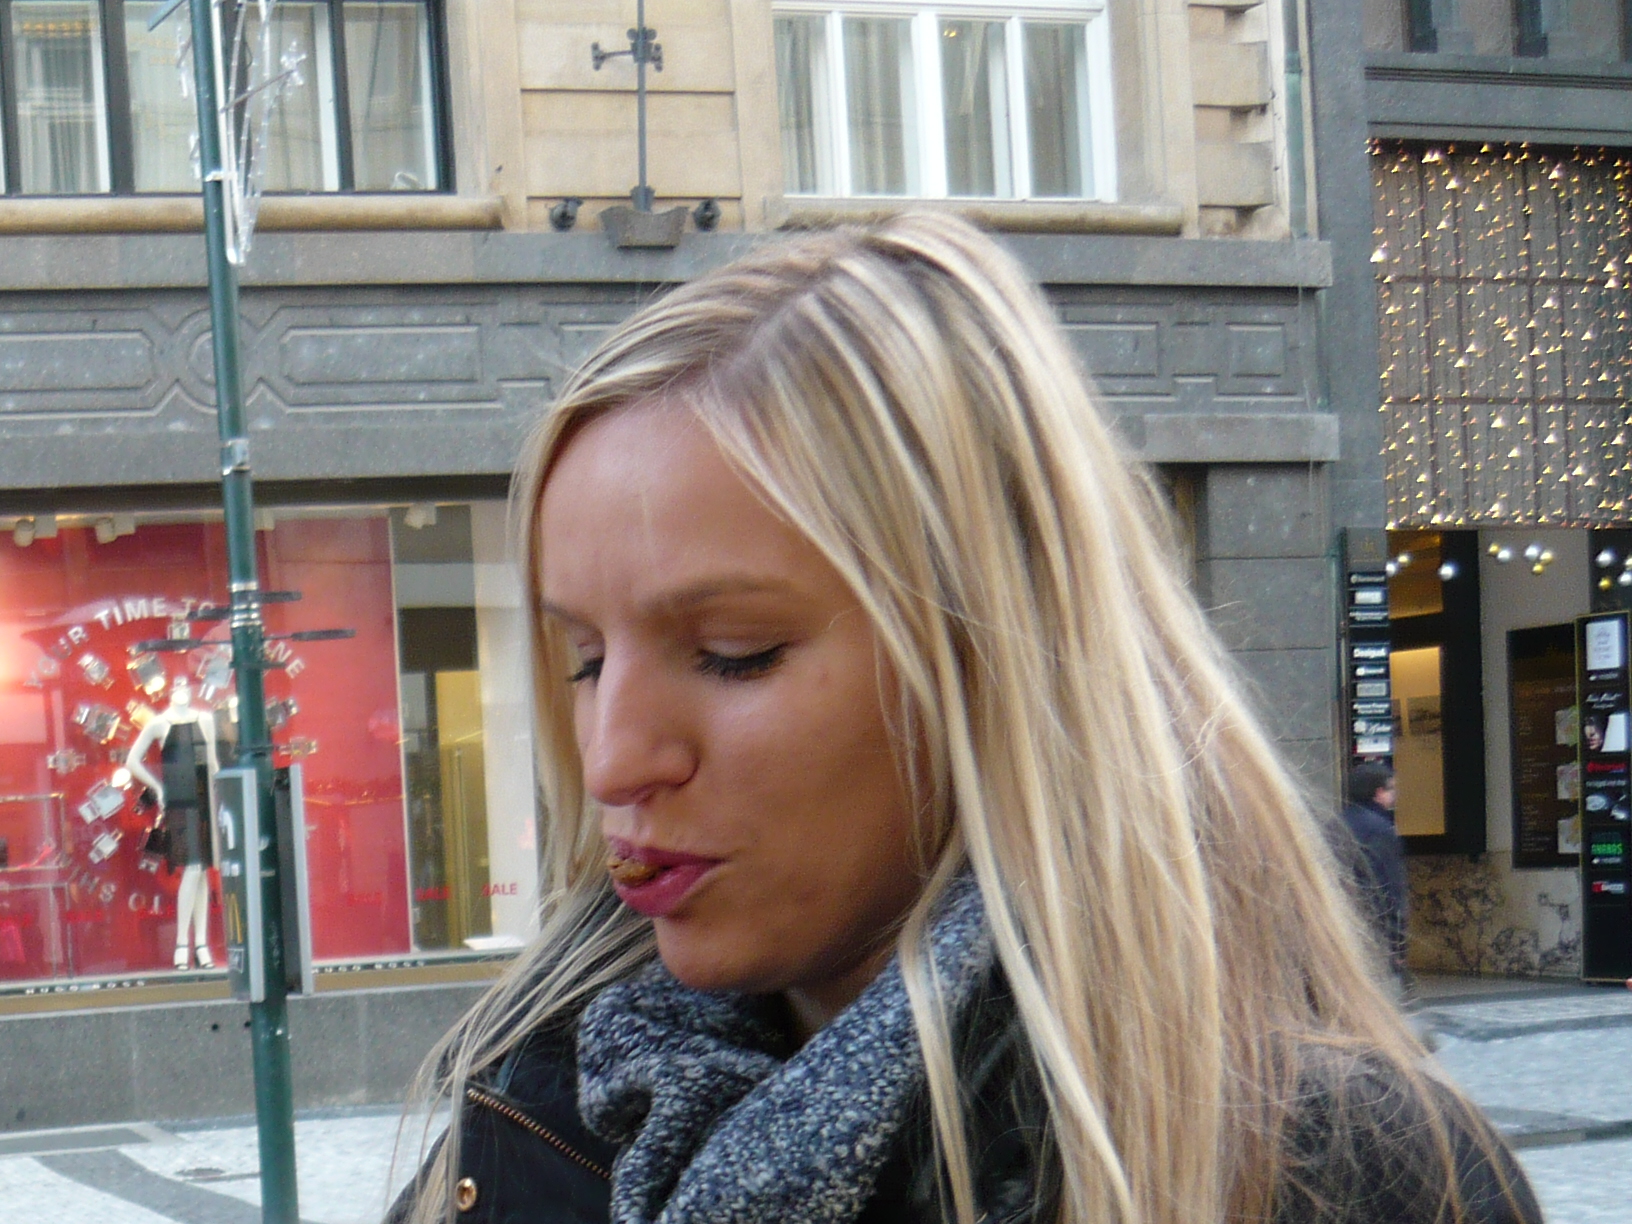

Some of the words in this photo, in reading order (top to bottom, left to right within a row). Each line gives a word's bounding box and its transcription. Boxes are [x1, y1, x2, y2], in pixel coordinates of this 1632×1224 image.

[24, 625, 90, 690] YOUR
[94, 597, 169, 631] TIME
[482, 883, 518, 897] SALE
